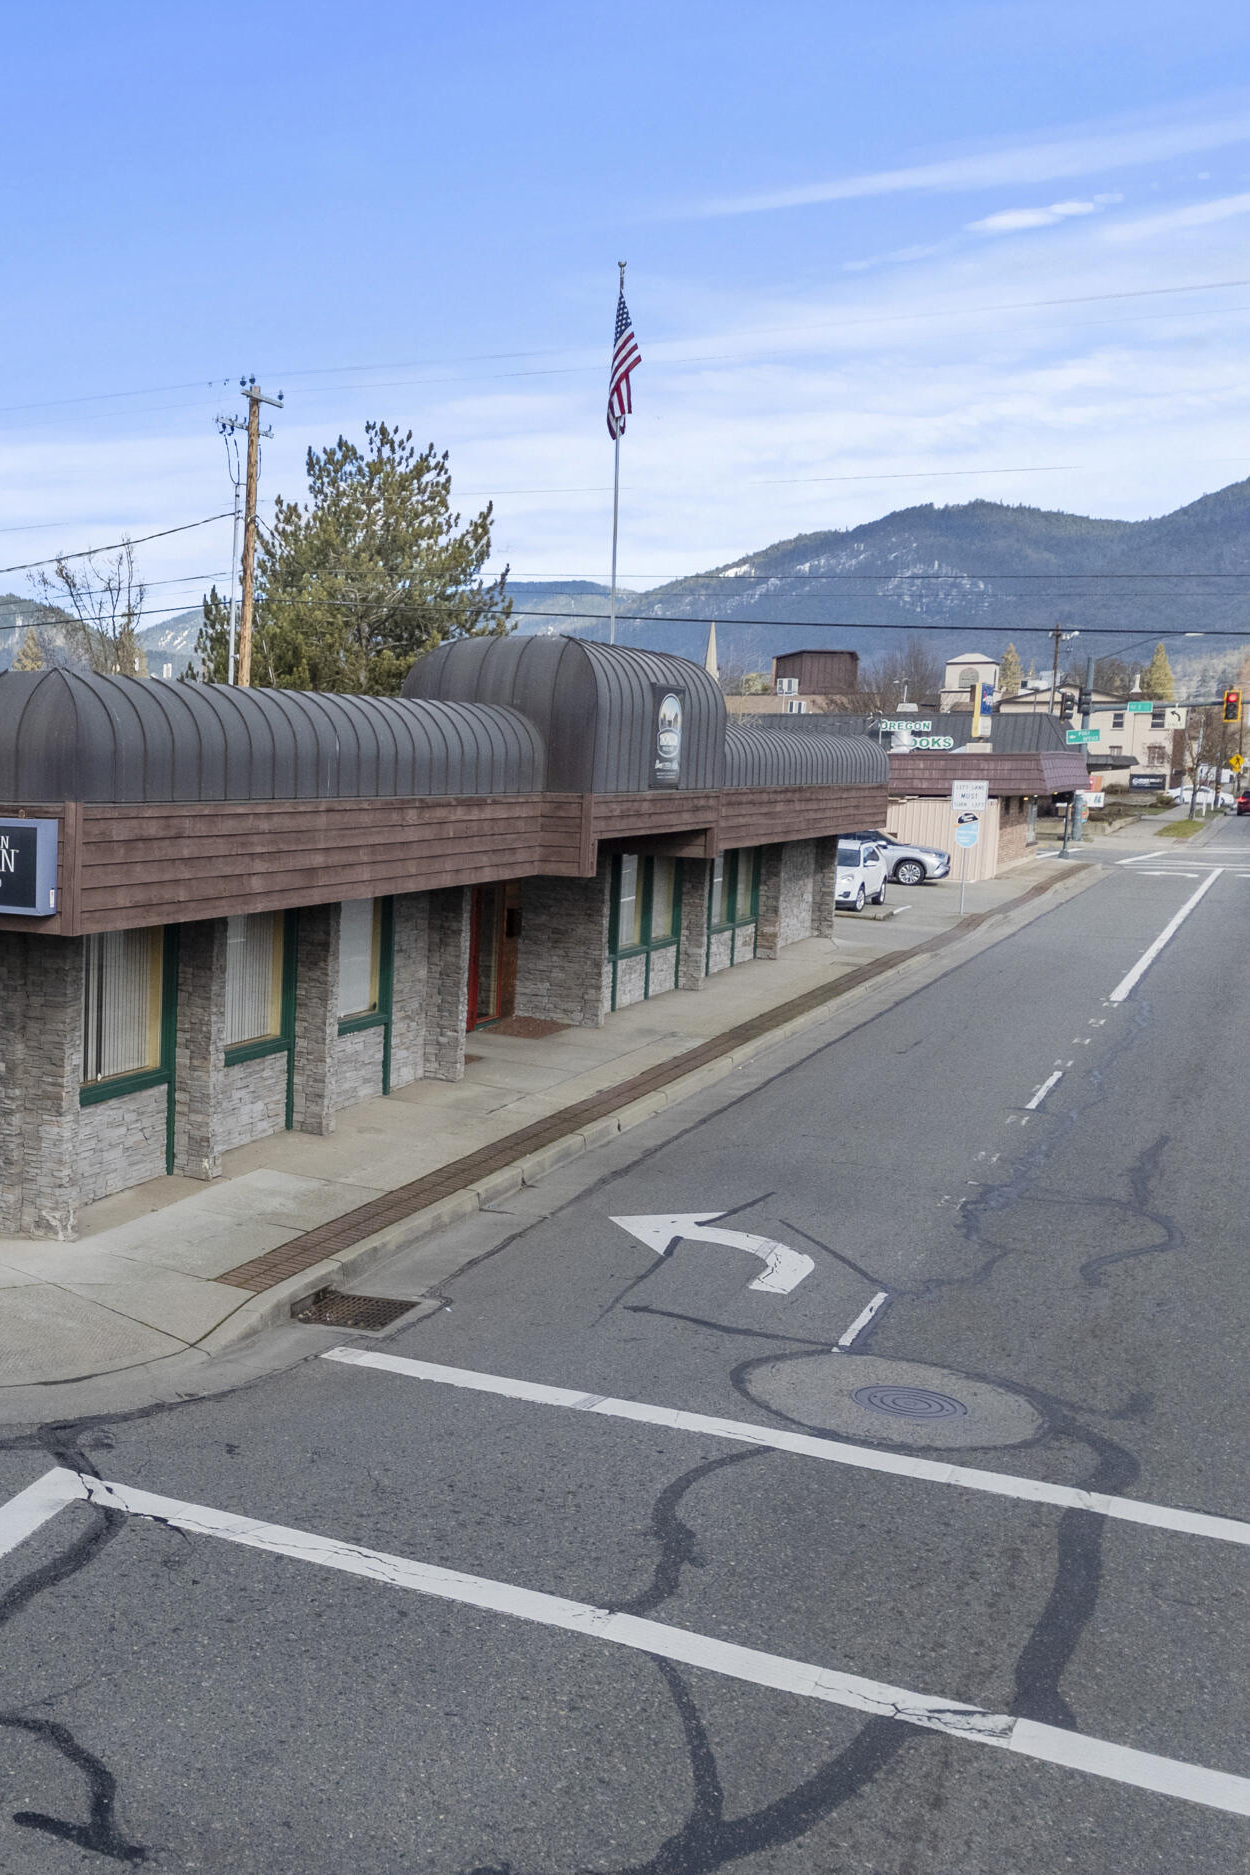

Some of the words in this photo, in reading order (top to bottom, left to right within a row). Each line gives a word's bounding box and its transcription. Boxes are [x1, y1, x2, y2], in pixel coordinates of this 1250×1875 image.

[881, 719, 931, 731] OREGON
[910, 736, 953, 749] OOKS
[961, 792, 978, 800] MUST
